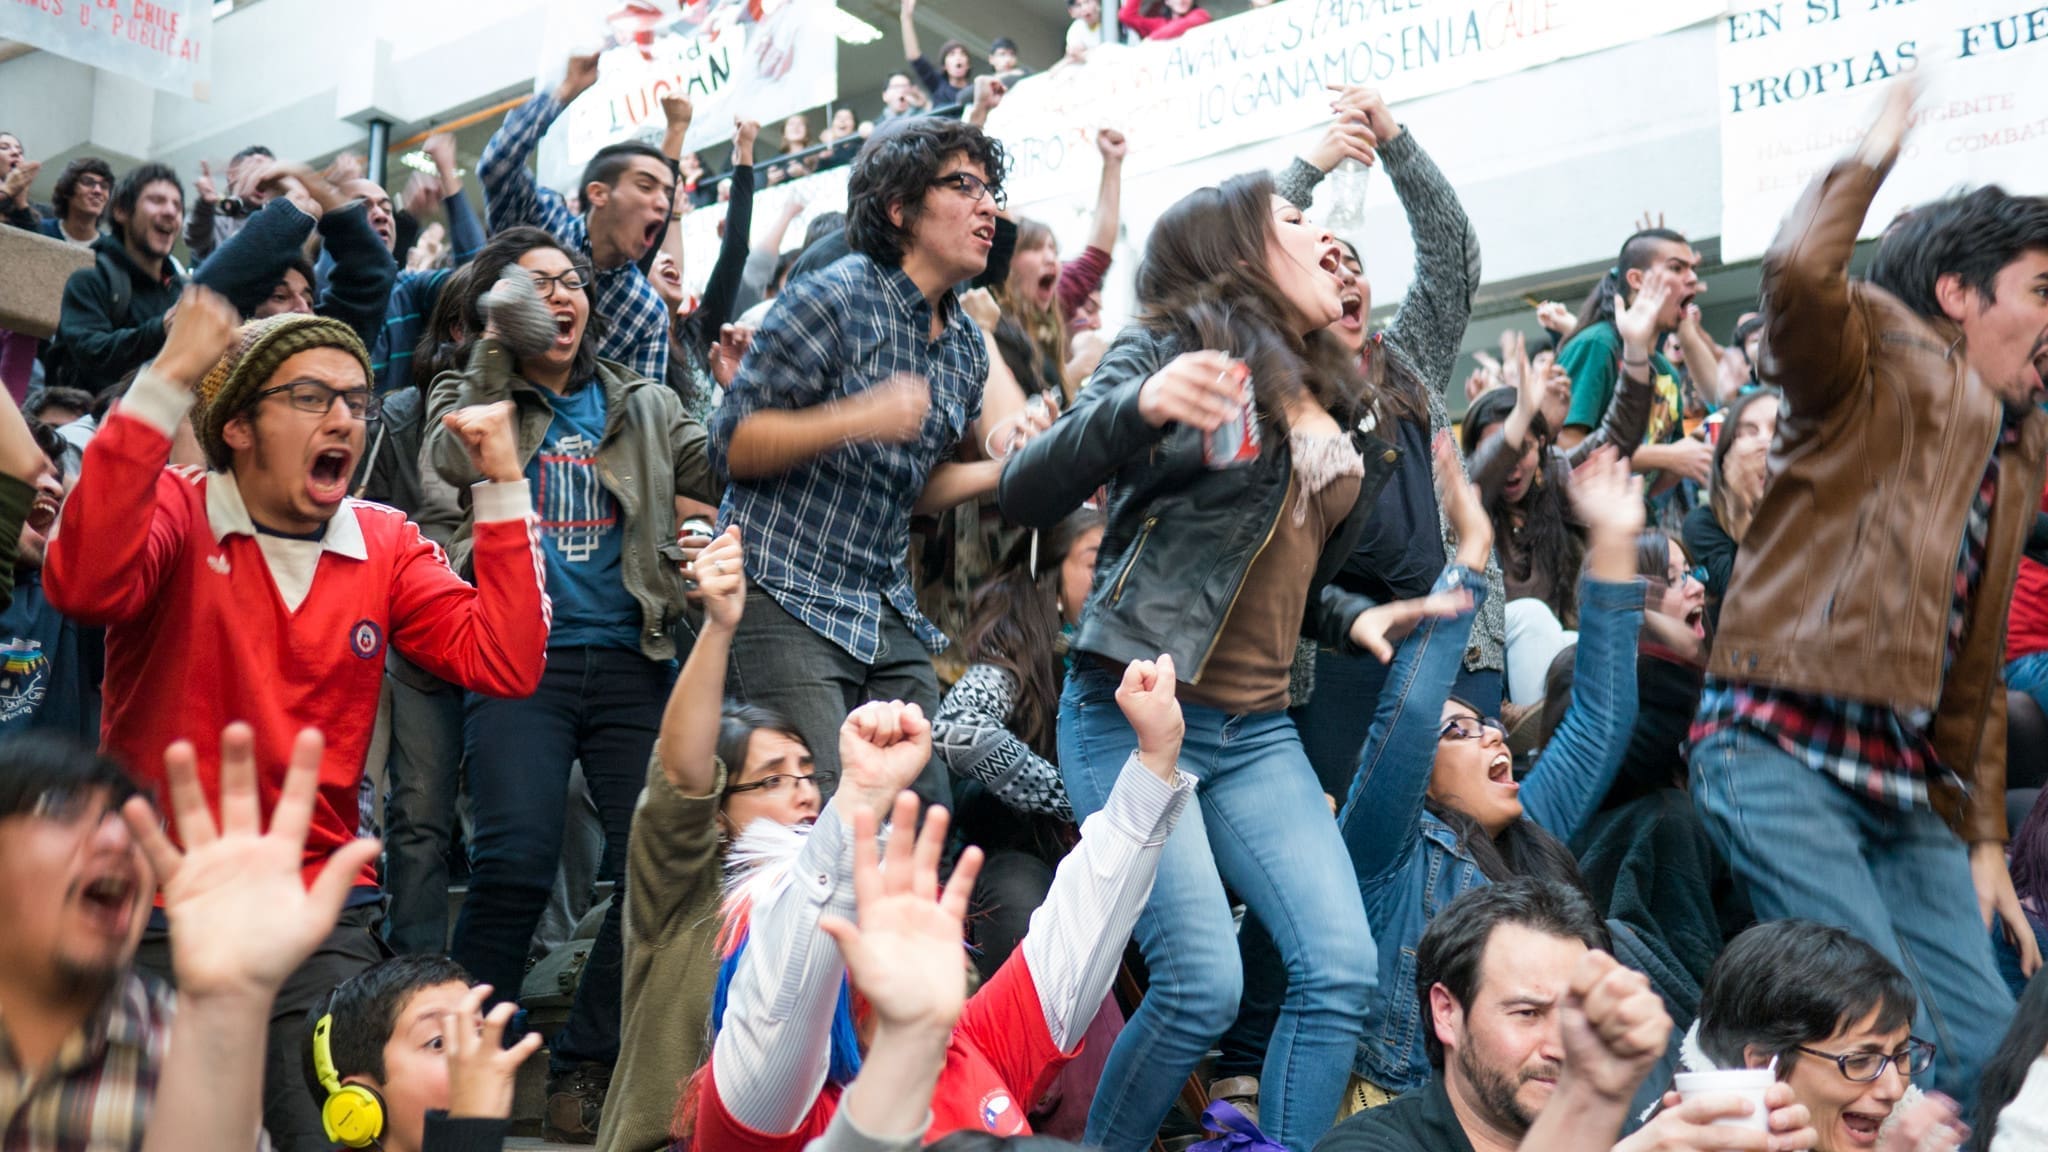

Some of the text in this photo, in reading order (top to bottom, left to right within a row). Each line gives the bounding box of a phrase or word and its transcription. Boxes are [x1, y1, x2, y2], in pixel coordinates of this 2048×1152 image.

[1726, 3, 1783, 43] EN
[1199, 85, 1226, 129] LO
[1232, 34, 1395, 116] GANAMOS
[1402, 19, 1440, 71] EN
[1448, 10, 1482, 58] LA
[1728, 40, 1919, 113] PROPIAS
